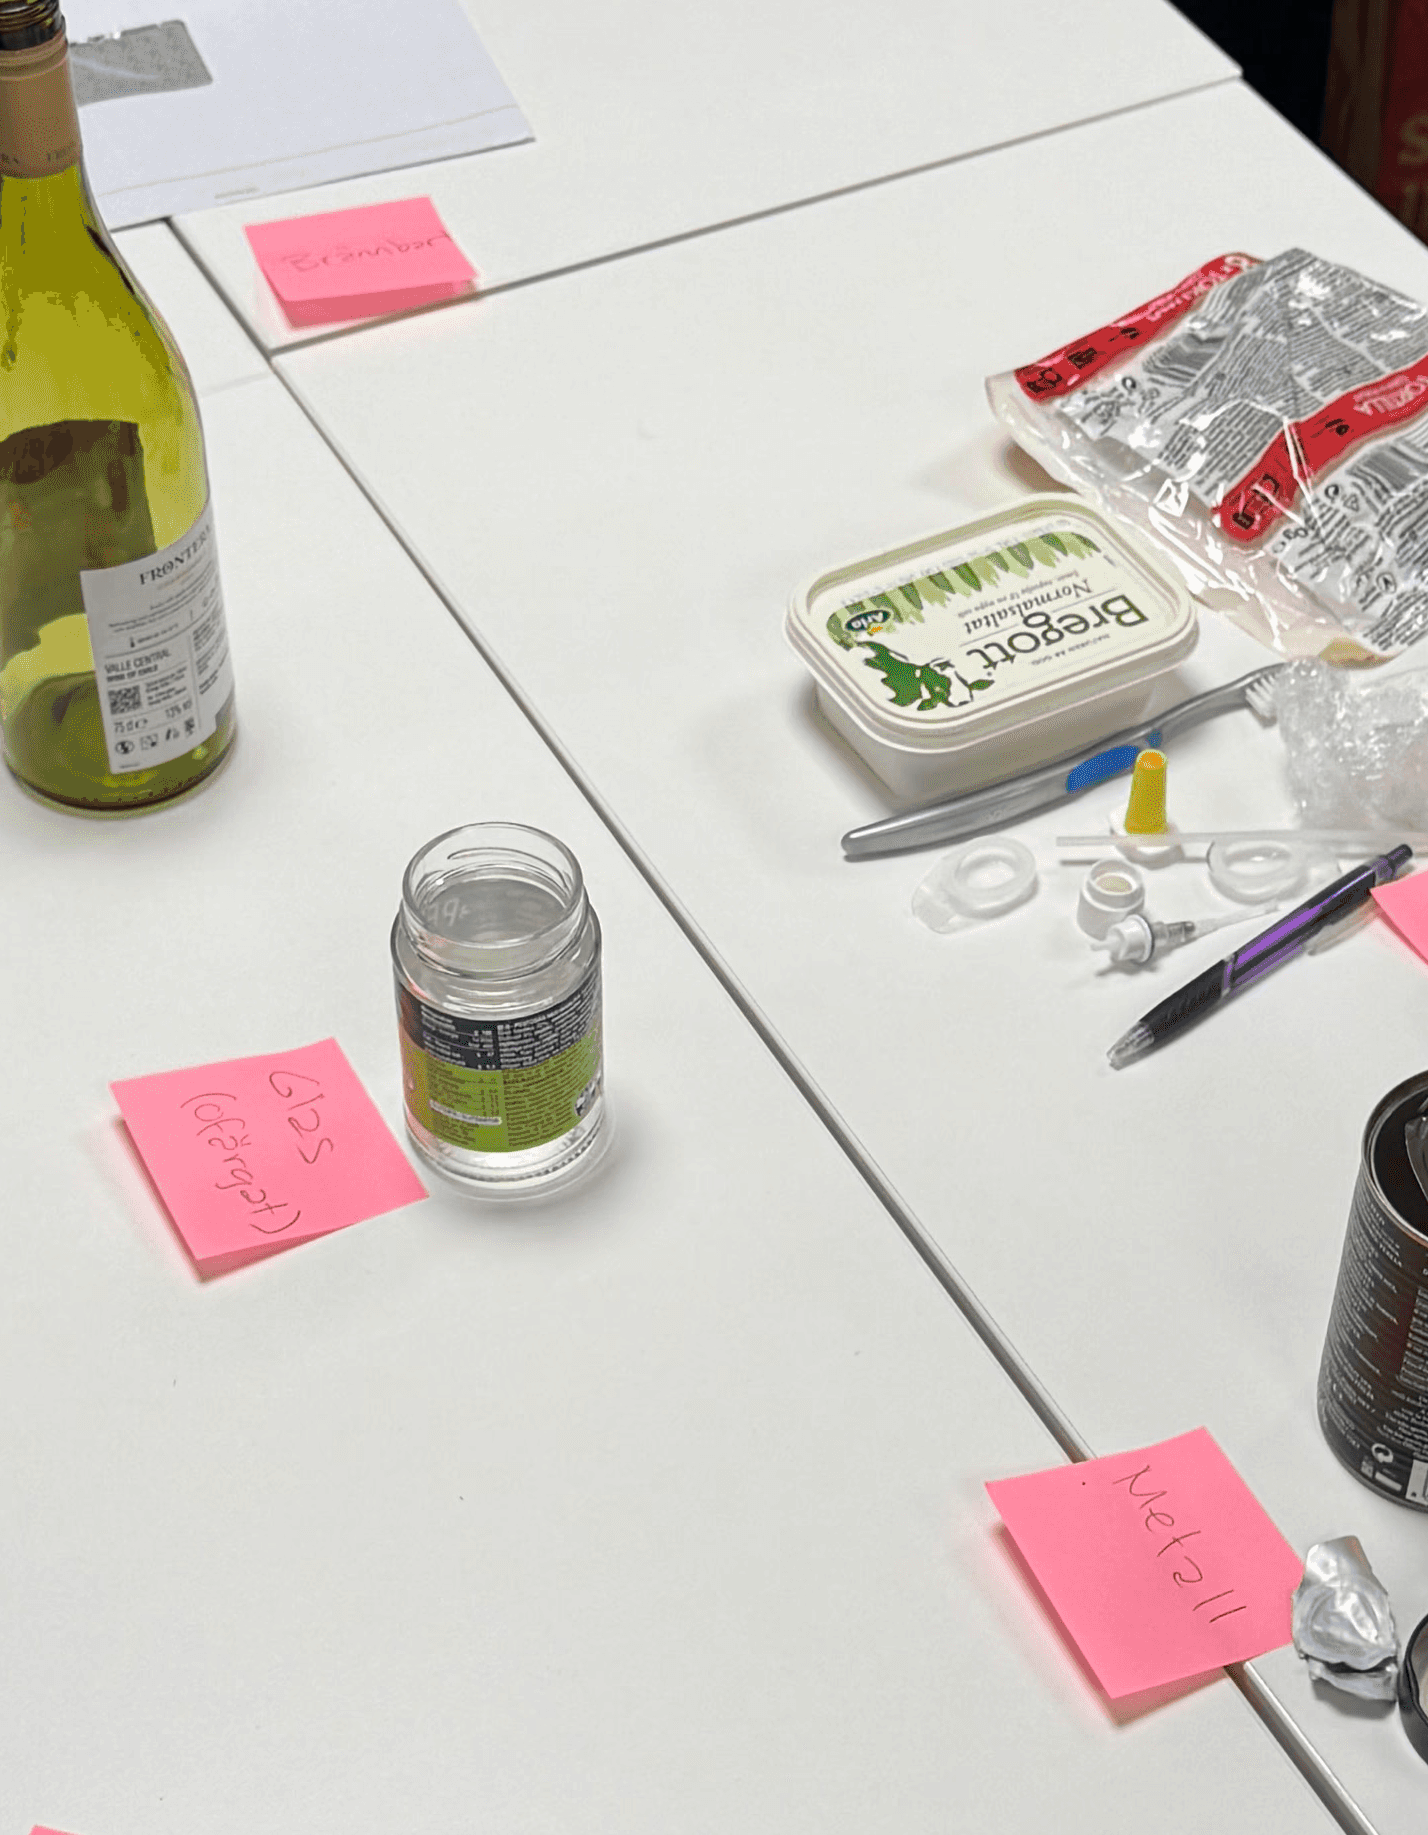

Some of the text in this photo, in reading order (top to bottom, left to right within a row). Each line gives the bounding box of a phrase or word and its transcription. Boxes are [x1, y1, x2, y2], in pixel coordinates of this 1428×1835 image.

[139, 523, 212, 586] FRONTER
[964, 578, 1093, 635] Normalsaltat
[965, 593, 1150, 671] Bregott
[268, 1069, 335, 1166] Glas
[1112, 1464, 1248, 1624] Metall
